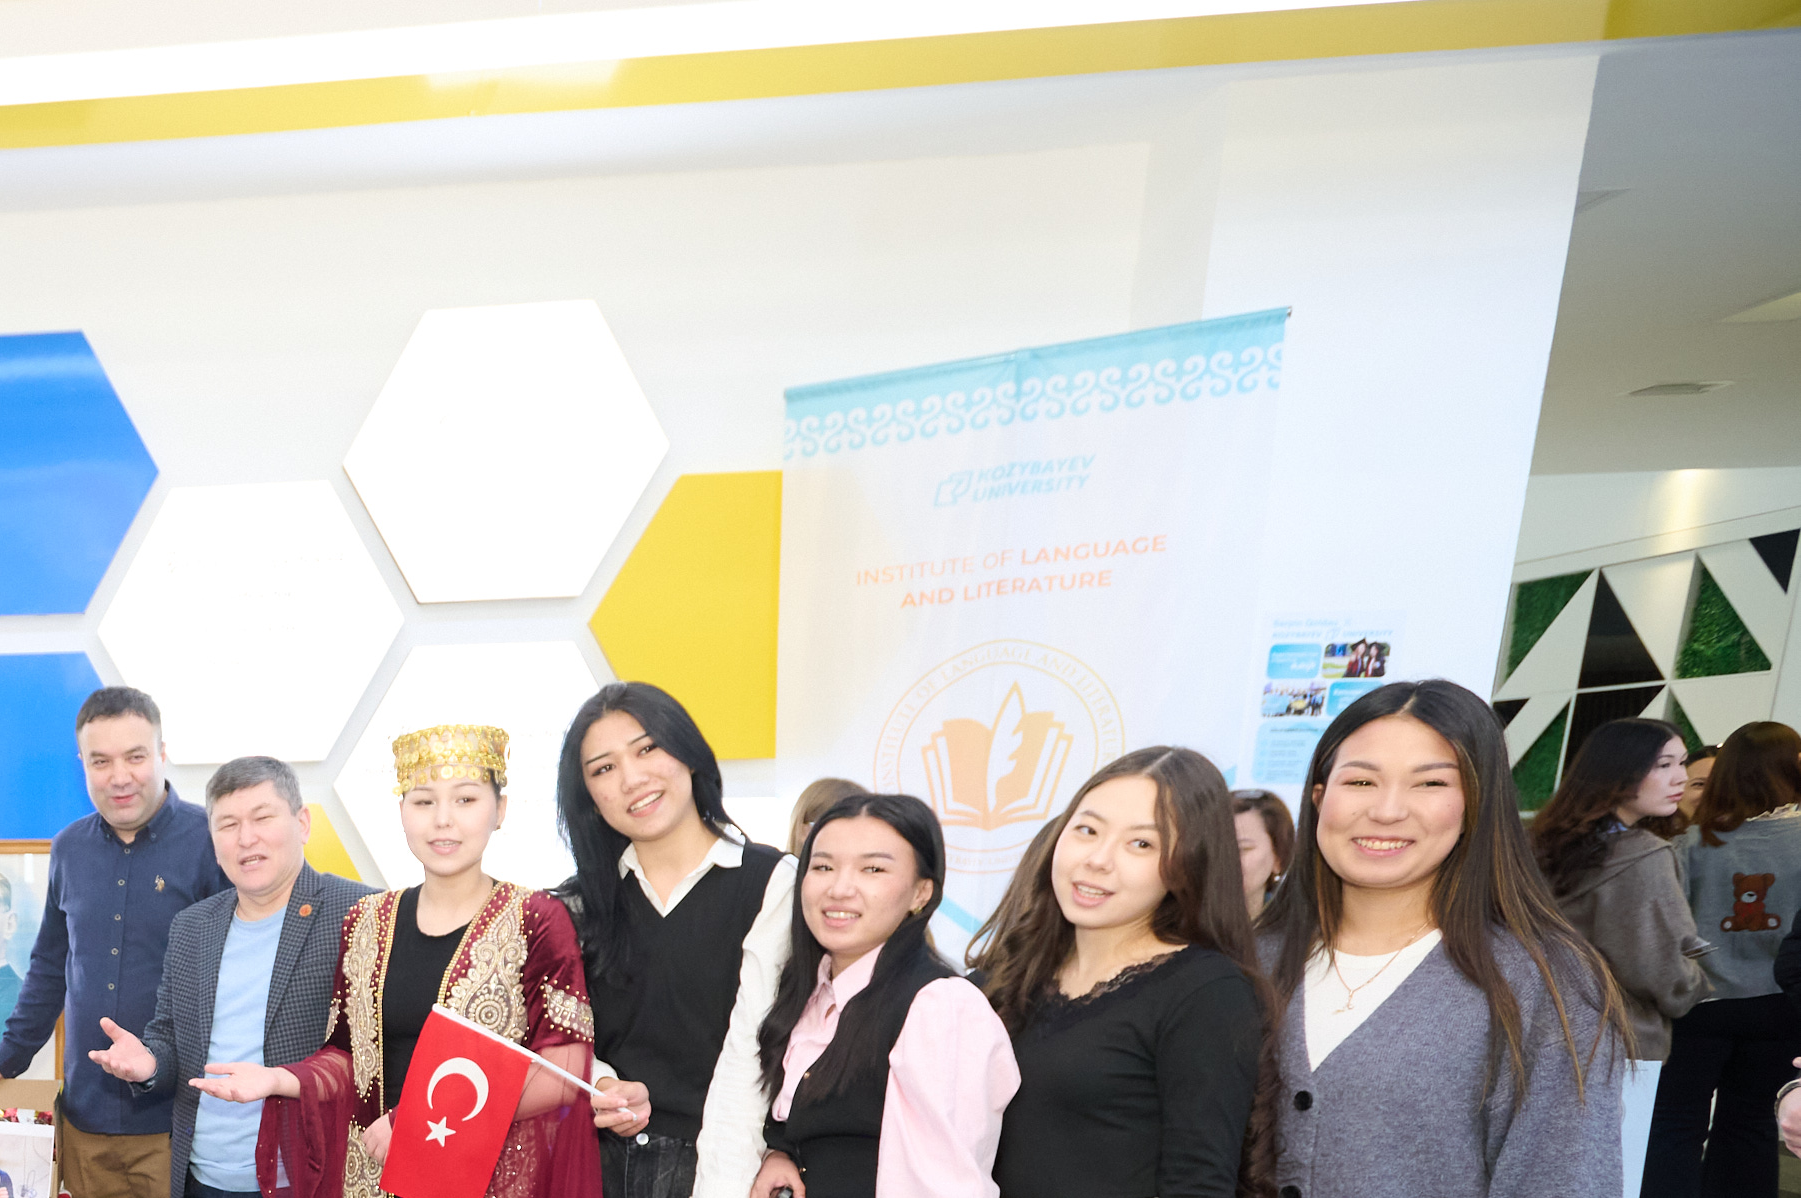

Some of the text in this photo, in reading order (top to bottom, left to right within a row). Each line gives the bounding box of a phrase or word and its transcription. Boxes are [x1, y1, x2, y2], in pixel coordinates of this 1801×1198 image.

[977, 453, 1096, 482] KOZYBAYEV
[972, 474, 1090, 502] UNIVERSITY
[856, 534, 1167, 586] INSTITUTE OF LANGUAGE
[900, 570, 1113, 609] AND LITERATURE
[916, 679, 938, 699] OF
[941, 646, 1032, 681] LANGUAGE
[1036, 653, 1077, 678] AND
[1076, 675, 1118, 762] LITERATUR
